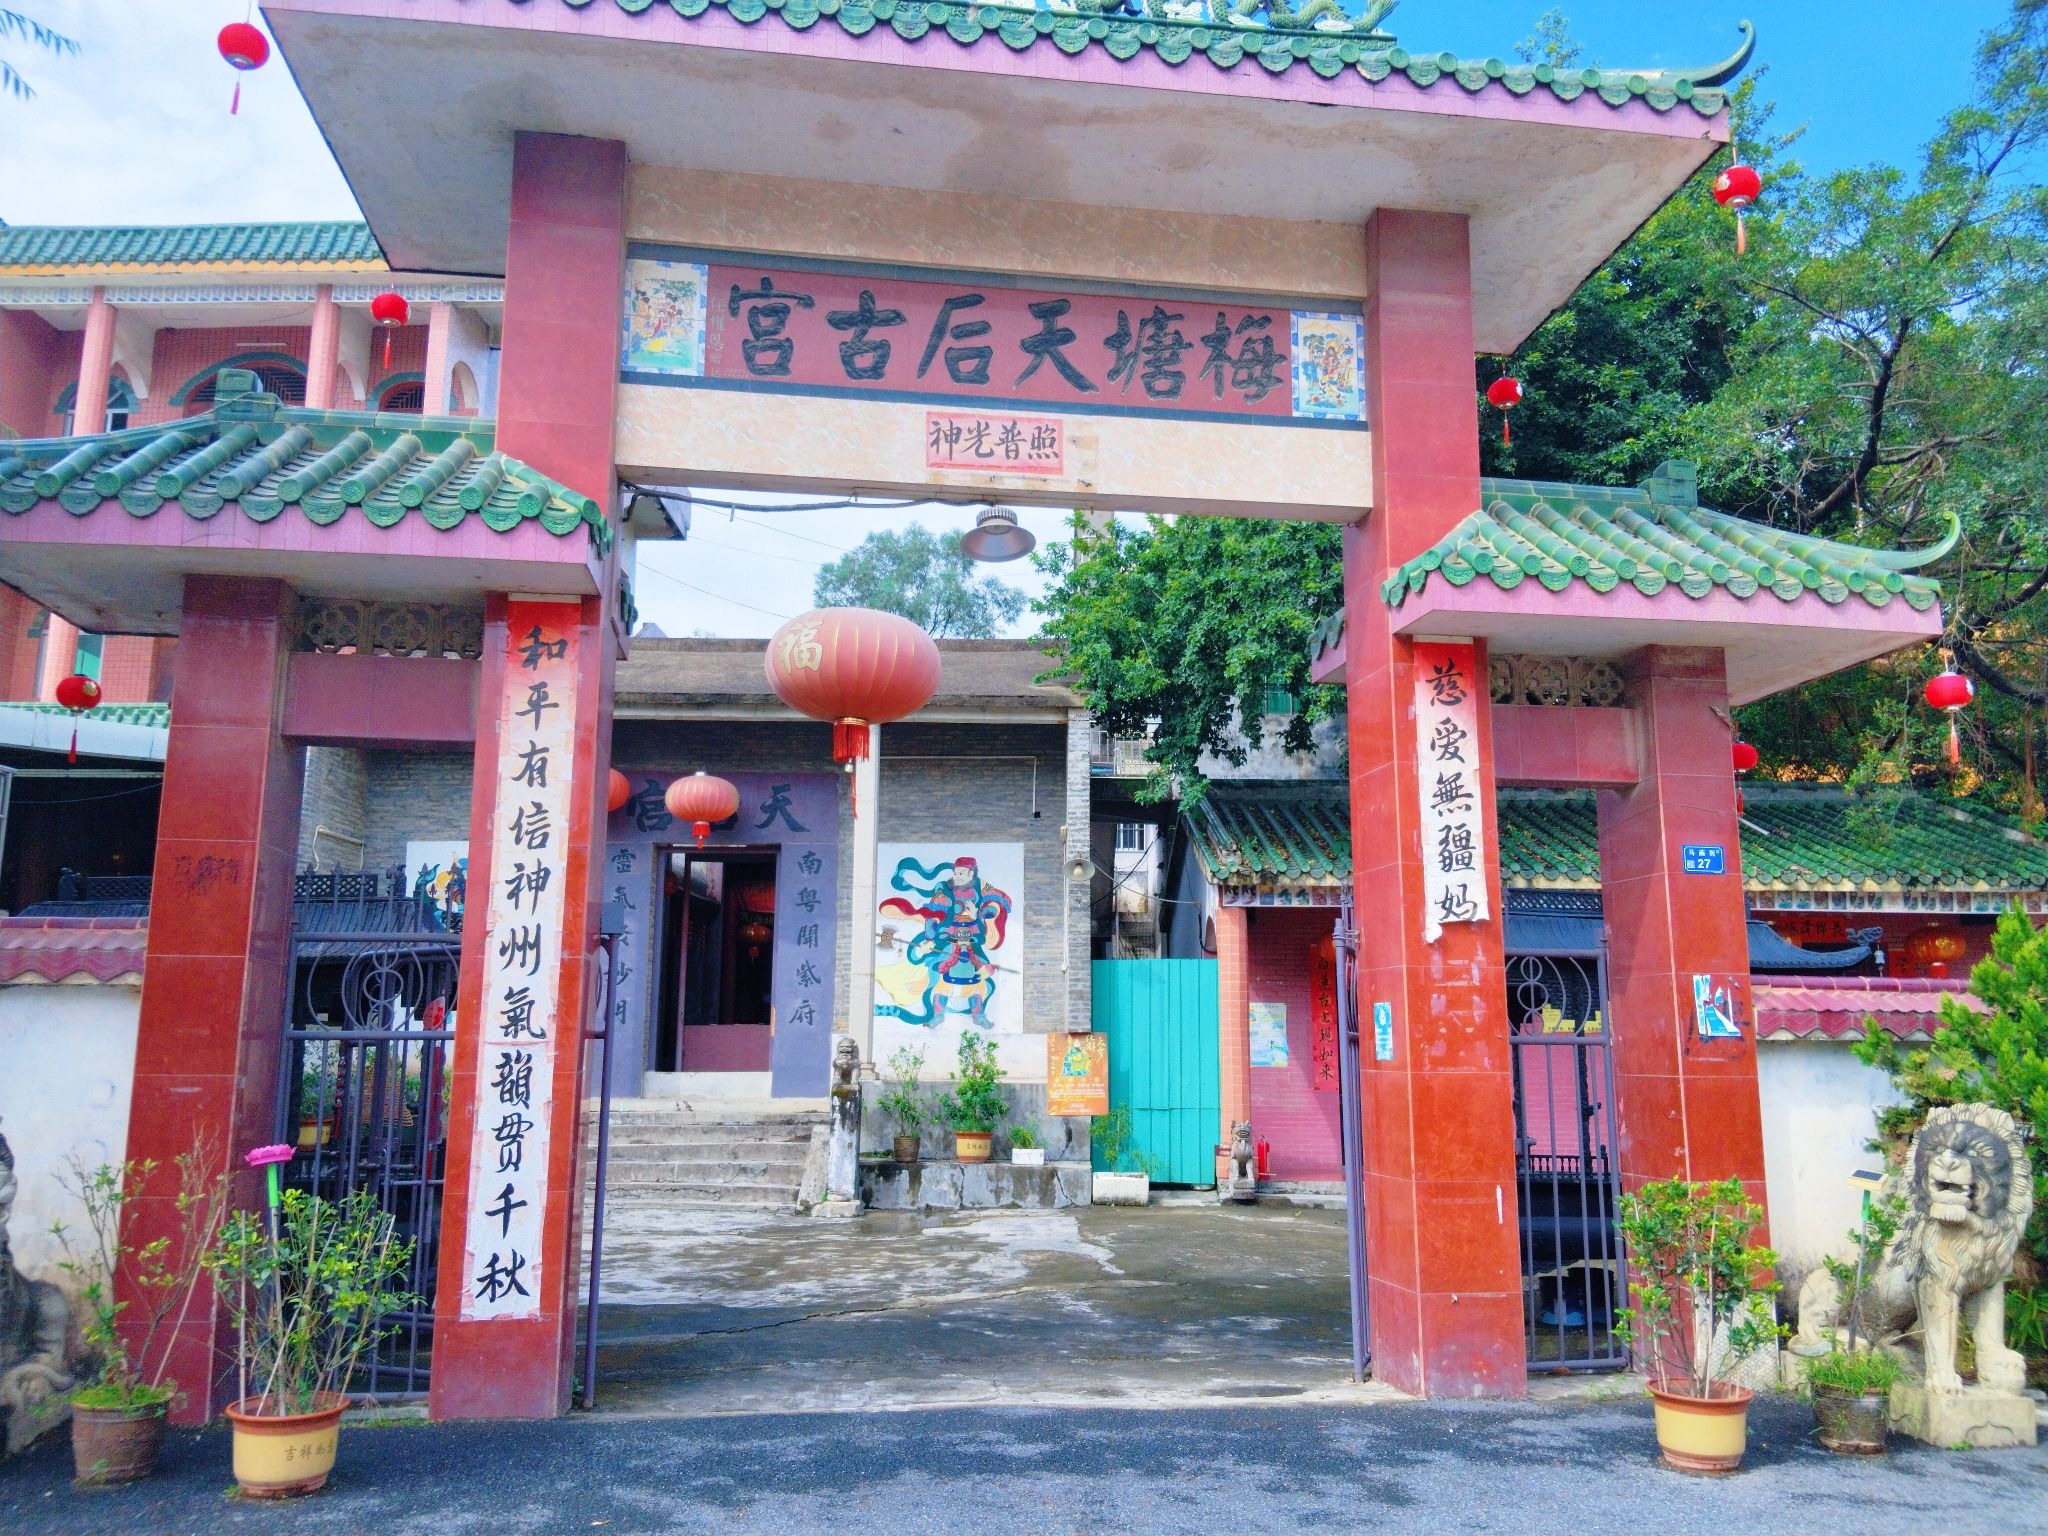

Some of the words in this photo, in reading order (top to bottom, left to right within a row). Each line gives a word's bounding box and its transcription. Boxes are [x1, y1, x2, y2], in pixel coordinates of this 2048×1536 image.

[929, 419, 1060, 461] 神光普照
[779, 619, 824, 675] 福
[1697, 858, 1711, 869] 27
